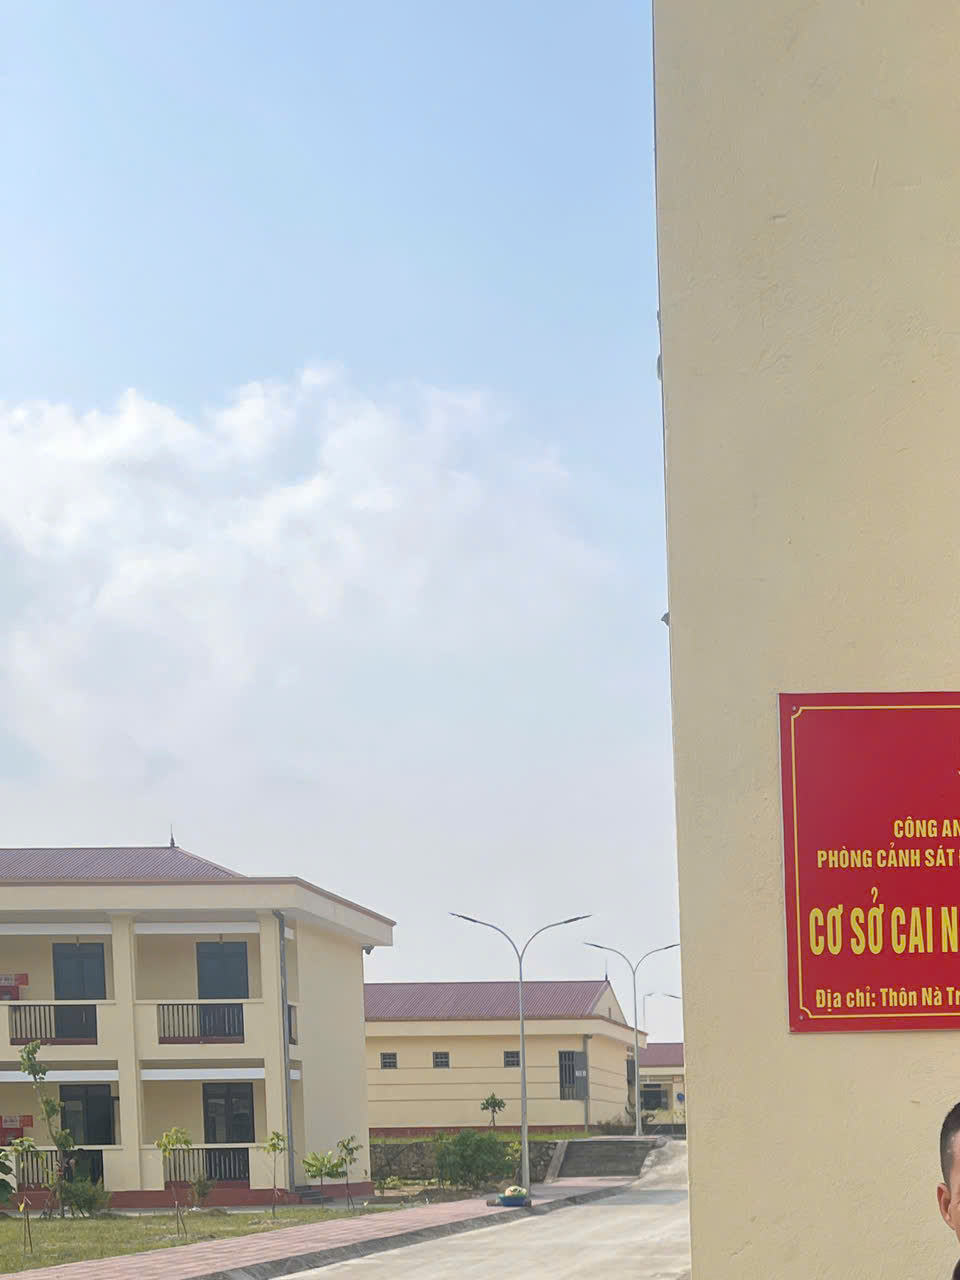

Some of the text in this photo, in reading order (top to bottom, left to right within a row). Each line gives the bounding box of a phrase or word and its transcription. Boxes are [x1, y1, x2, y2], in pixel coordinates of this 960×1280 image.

[894, 815, 937, 838] CÔNG
[817, 846, 872, 868] PHÒNG
[877, 842, 920, 867] CẢNH
[925, 844, 955, 867] SÁT
[808, 903, 844, 956] CƠ
[851, 886, 885, 955] SỞ
[890, 905, 933, 953] CAI
[815, 989, 842, 1012] Địa
[846, 985, 877, 1008] chỉ:
[880, 987, 917, 1007] Thôn
[922, 986, 942, 1006] Nà
